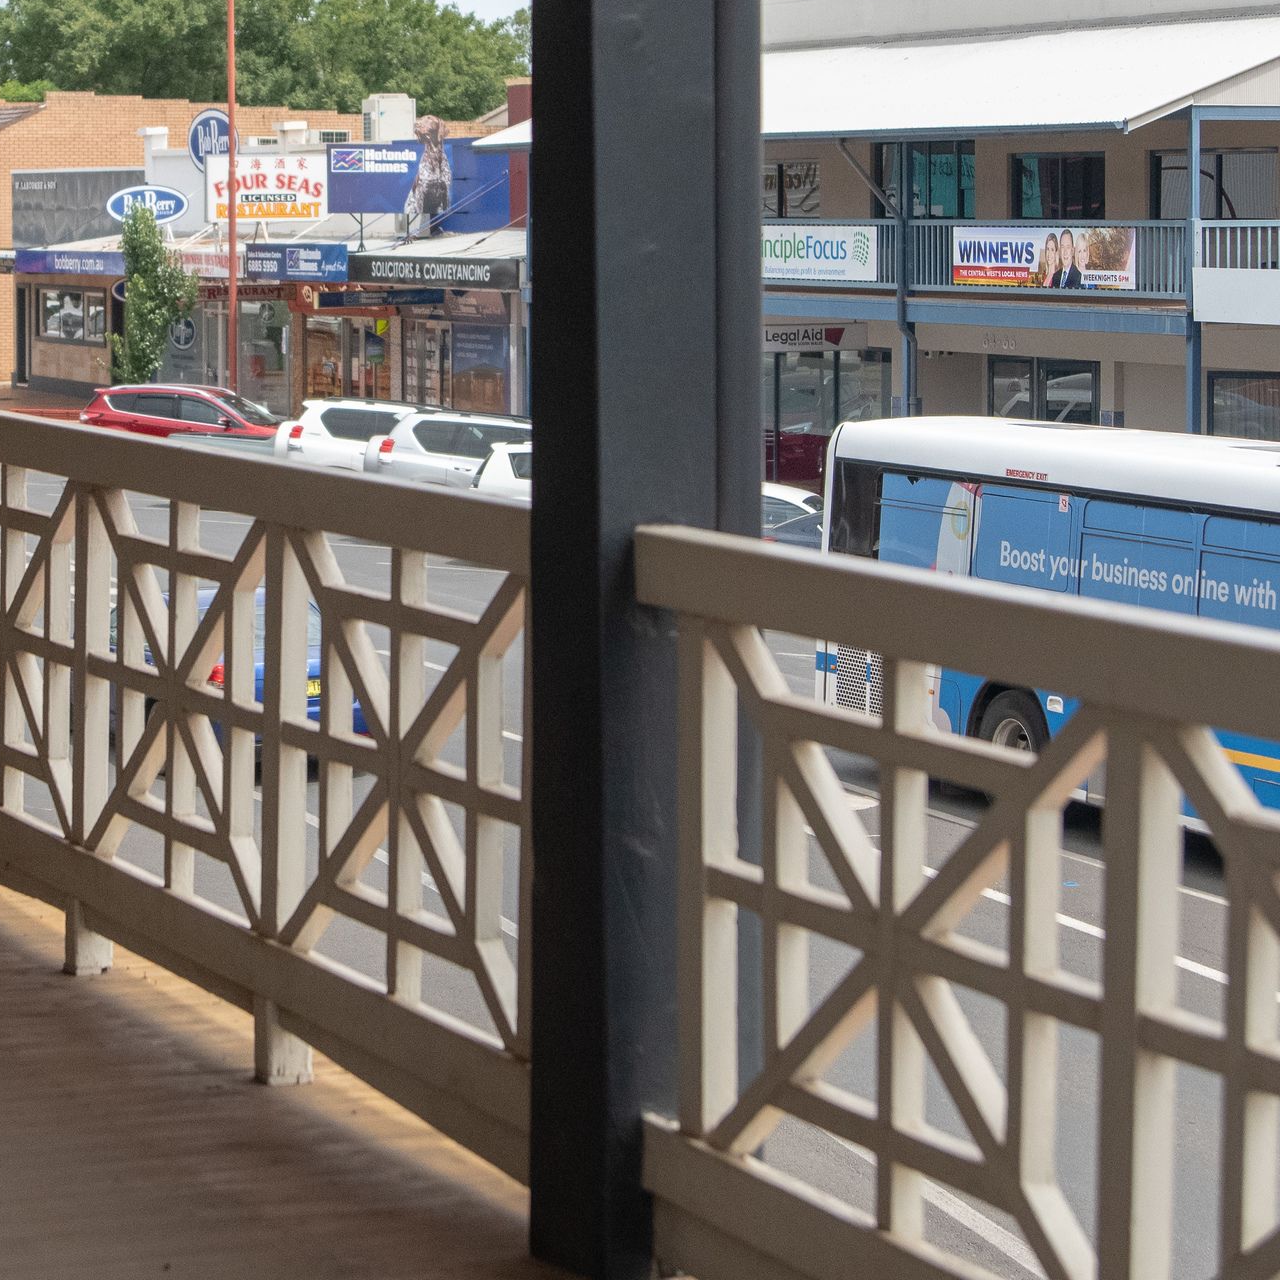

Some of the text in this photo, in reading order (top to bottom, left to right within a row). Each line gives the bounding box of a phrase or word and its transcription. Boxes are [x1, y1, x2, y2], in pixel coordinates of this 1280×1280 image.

[365, 149, 417, 161] Hotondo
[365, 161, 409, 173] Homes
[276, 173, 324, 198] SEAS
[241, 194, 296, 202] LICENSED
[216, 202, 321, 219] RSTAURANT
[55, 254, 104, 273] bobberry.com.au
[248, 260, 262, 272] 6885
[371, 261, 491, 282] SOLICITORS & CONVEYANCING
[1083, 273, 1118, 282] WEEKNIGHTS
[765, 328, 823, 344] Legal Aid
[1006, 469, 1048, 481] EMERGENCY EXIT
[1000, 540, 1045, 573] Boost
[1050, 552, 1088, 580] your
[1092, 553, 1167, 592] business
[1172, 569, 1229, 603] online
[1234, 578, 1276, 610] with
